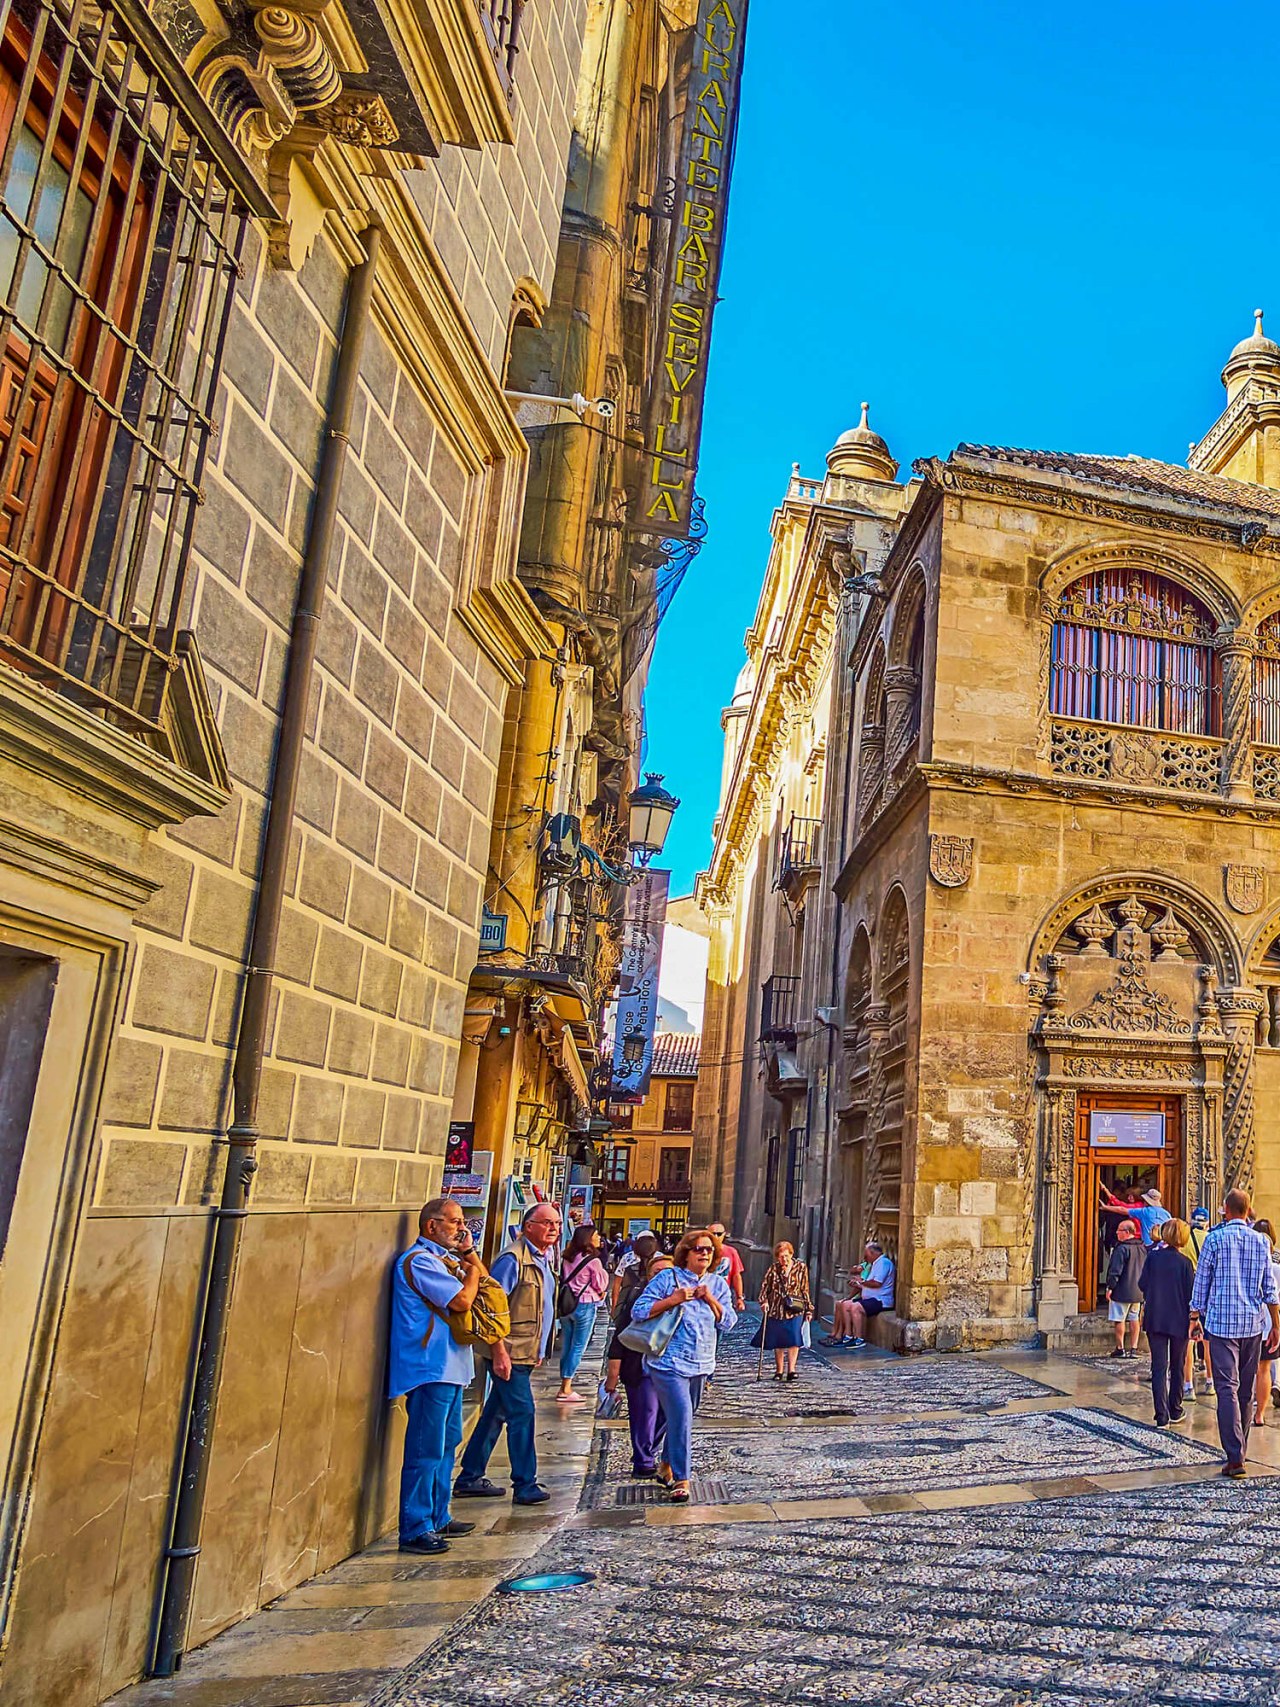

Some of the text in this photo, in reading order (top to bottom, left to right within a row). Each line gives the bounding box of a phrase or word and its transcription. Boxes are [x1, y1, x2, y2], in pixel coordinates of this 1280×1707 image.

[646, 0, 736, 523] AURANTE BAR SEVILLA
[627, 958, 636, 972] The
[632, 889, 643, 927] prmanent
[636, 939, 646, 973] collection
[635, 979, 651, 1031] Peña-Toro
